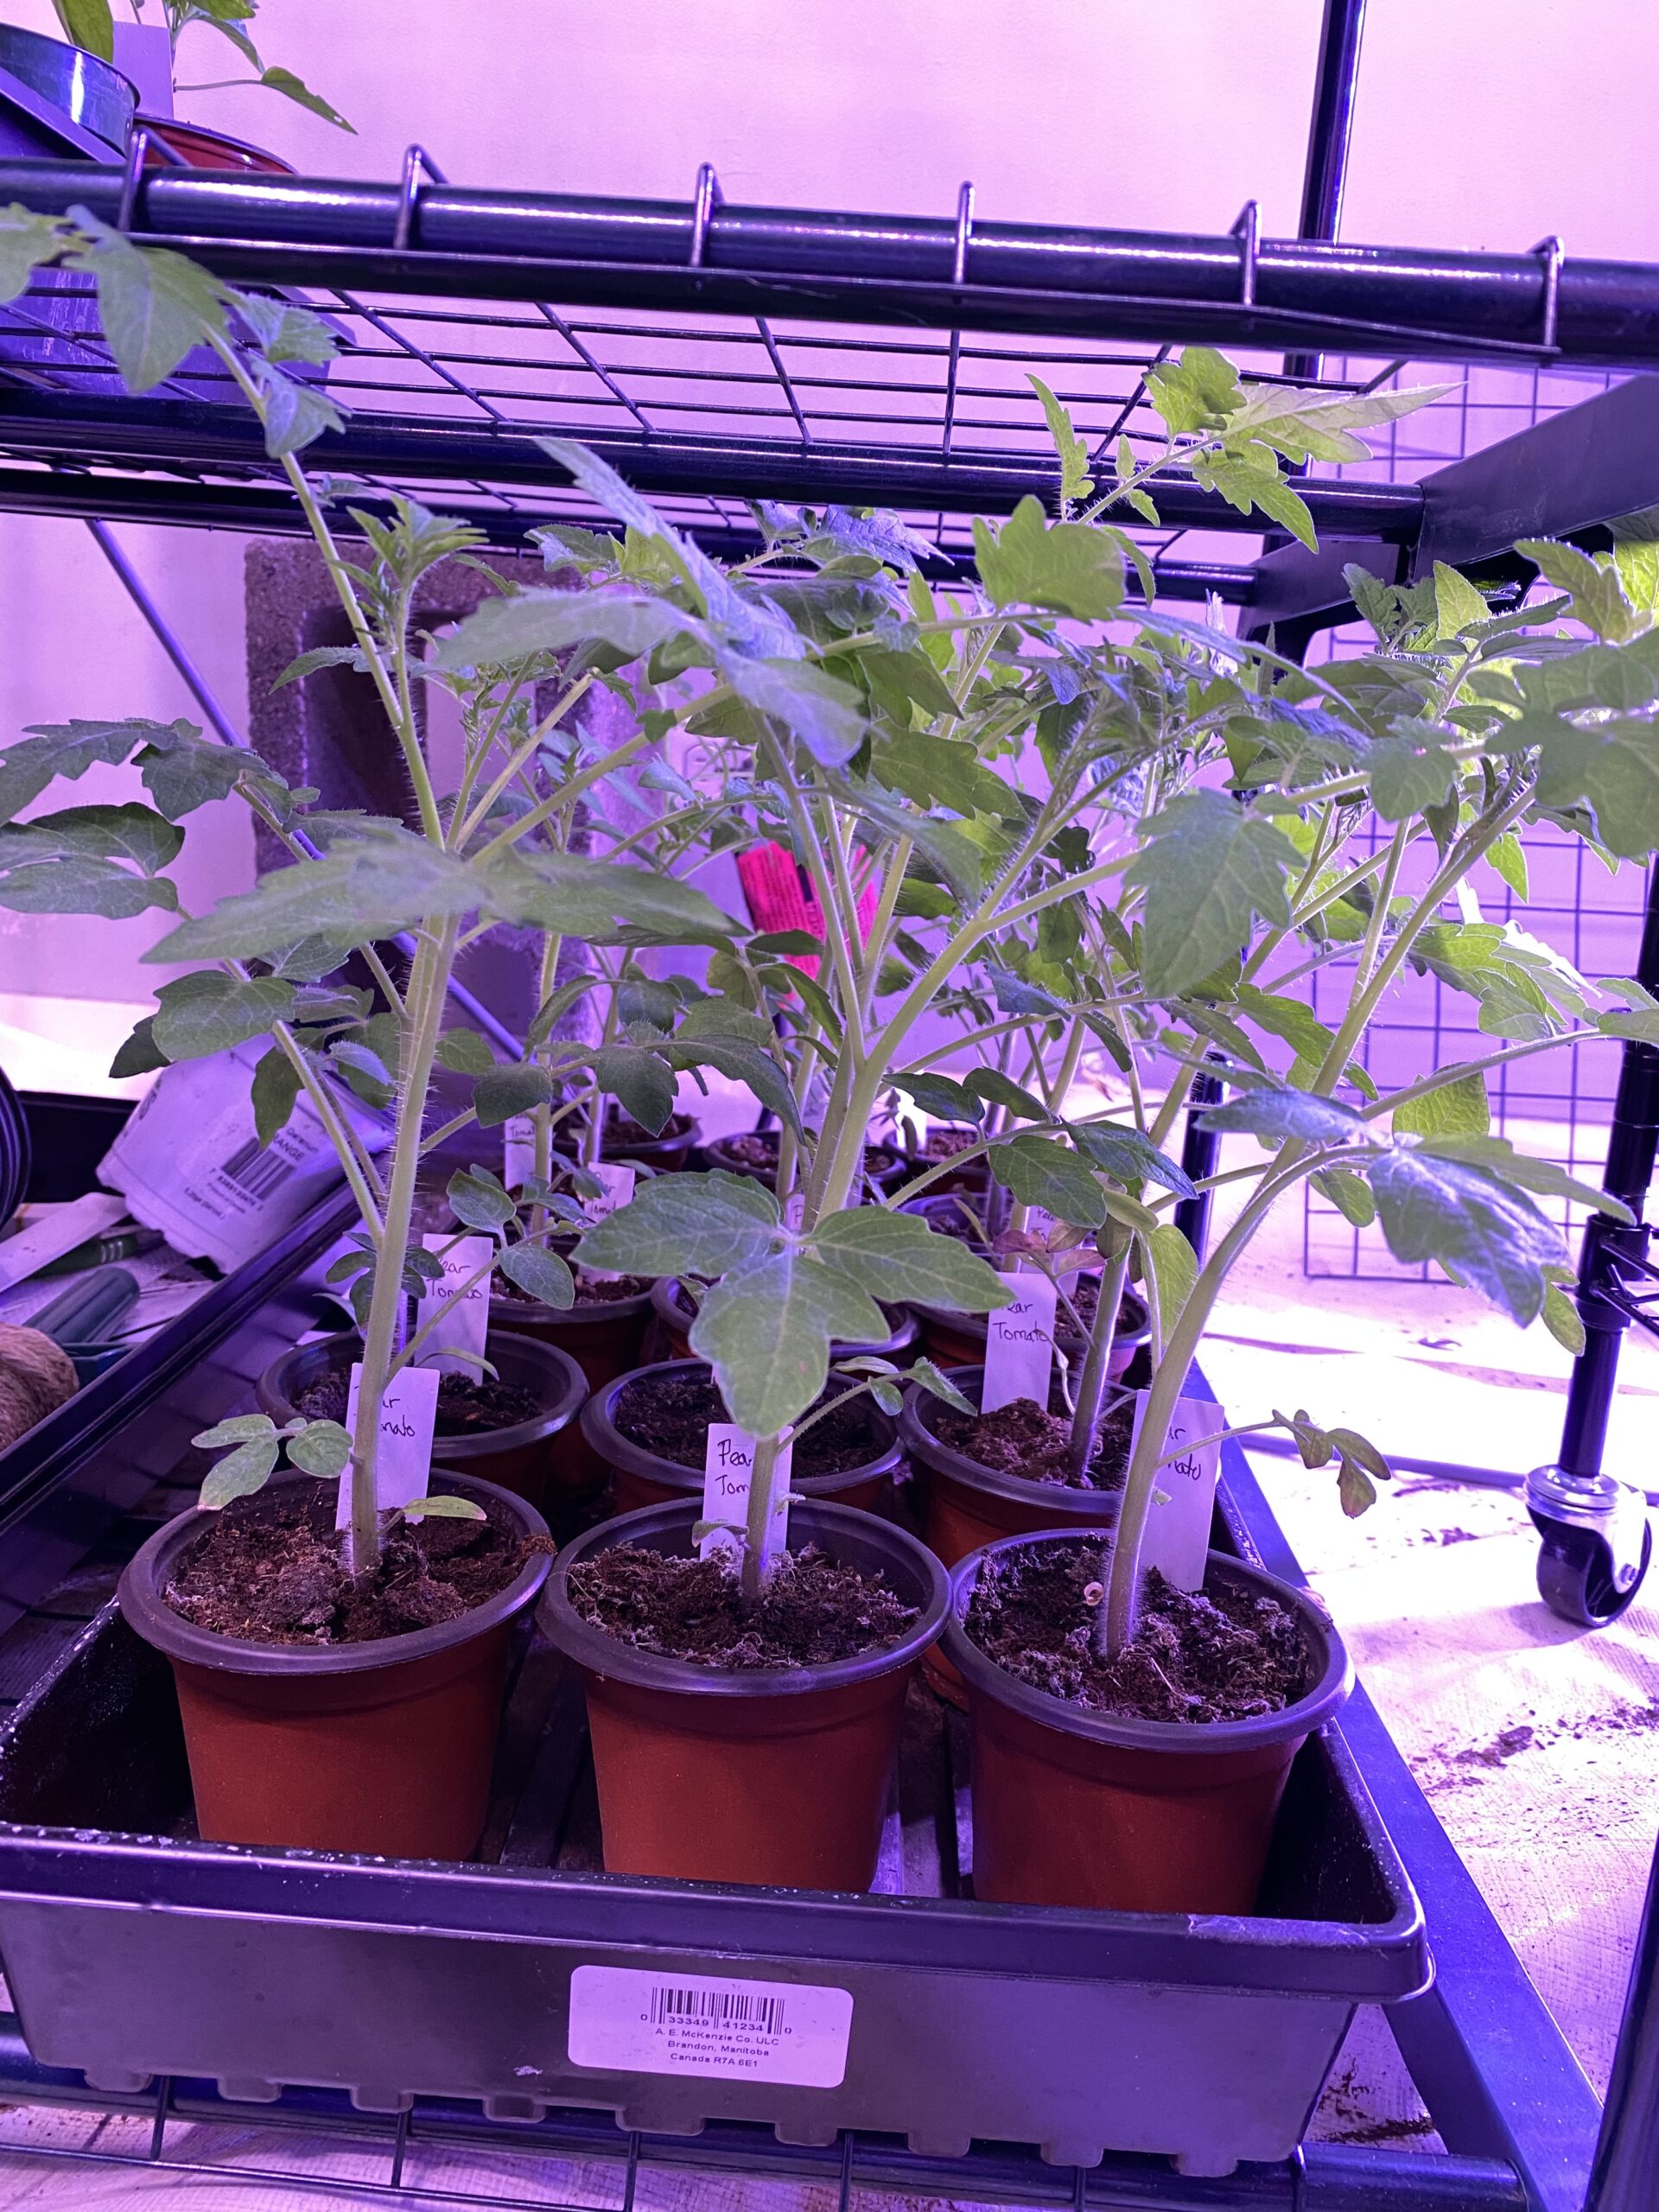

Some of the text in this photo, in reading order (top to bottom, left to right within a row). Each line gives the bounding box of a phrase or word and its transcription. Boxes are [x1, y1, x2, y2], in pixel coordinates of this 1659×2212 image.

[1007, 1302, 1034, 1314] ear
[715, 1474, 749, 1496] Tom
[668, 2016, 709, 2027] 33349
[722, 2021, 764, 2031] 41234
[682, 2030, 733, 2041] McKenzie
[756, 2037, 779, 2045] ULC
[668, 2040, 769, 2056] Brandon, Manitoba
[671, 2053, 710, 2063] Canada
[714, 2056, 735, 2065] R7A
